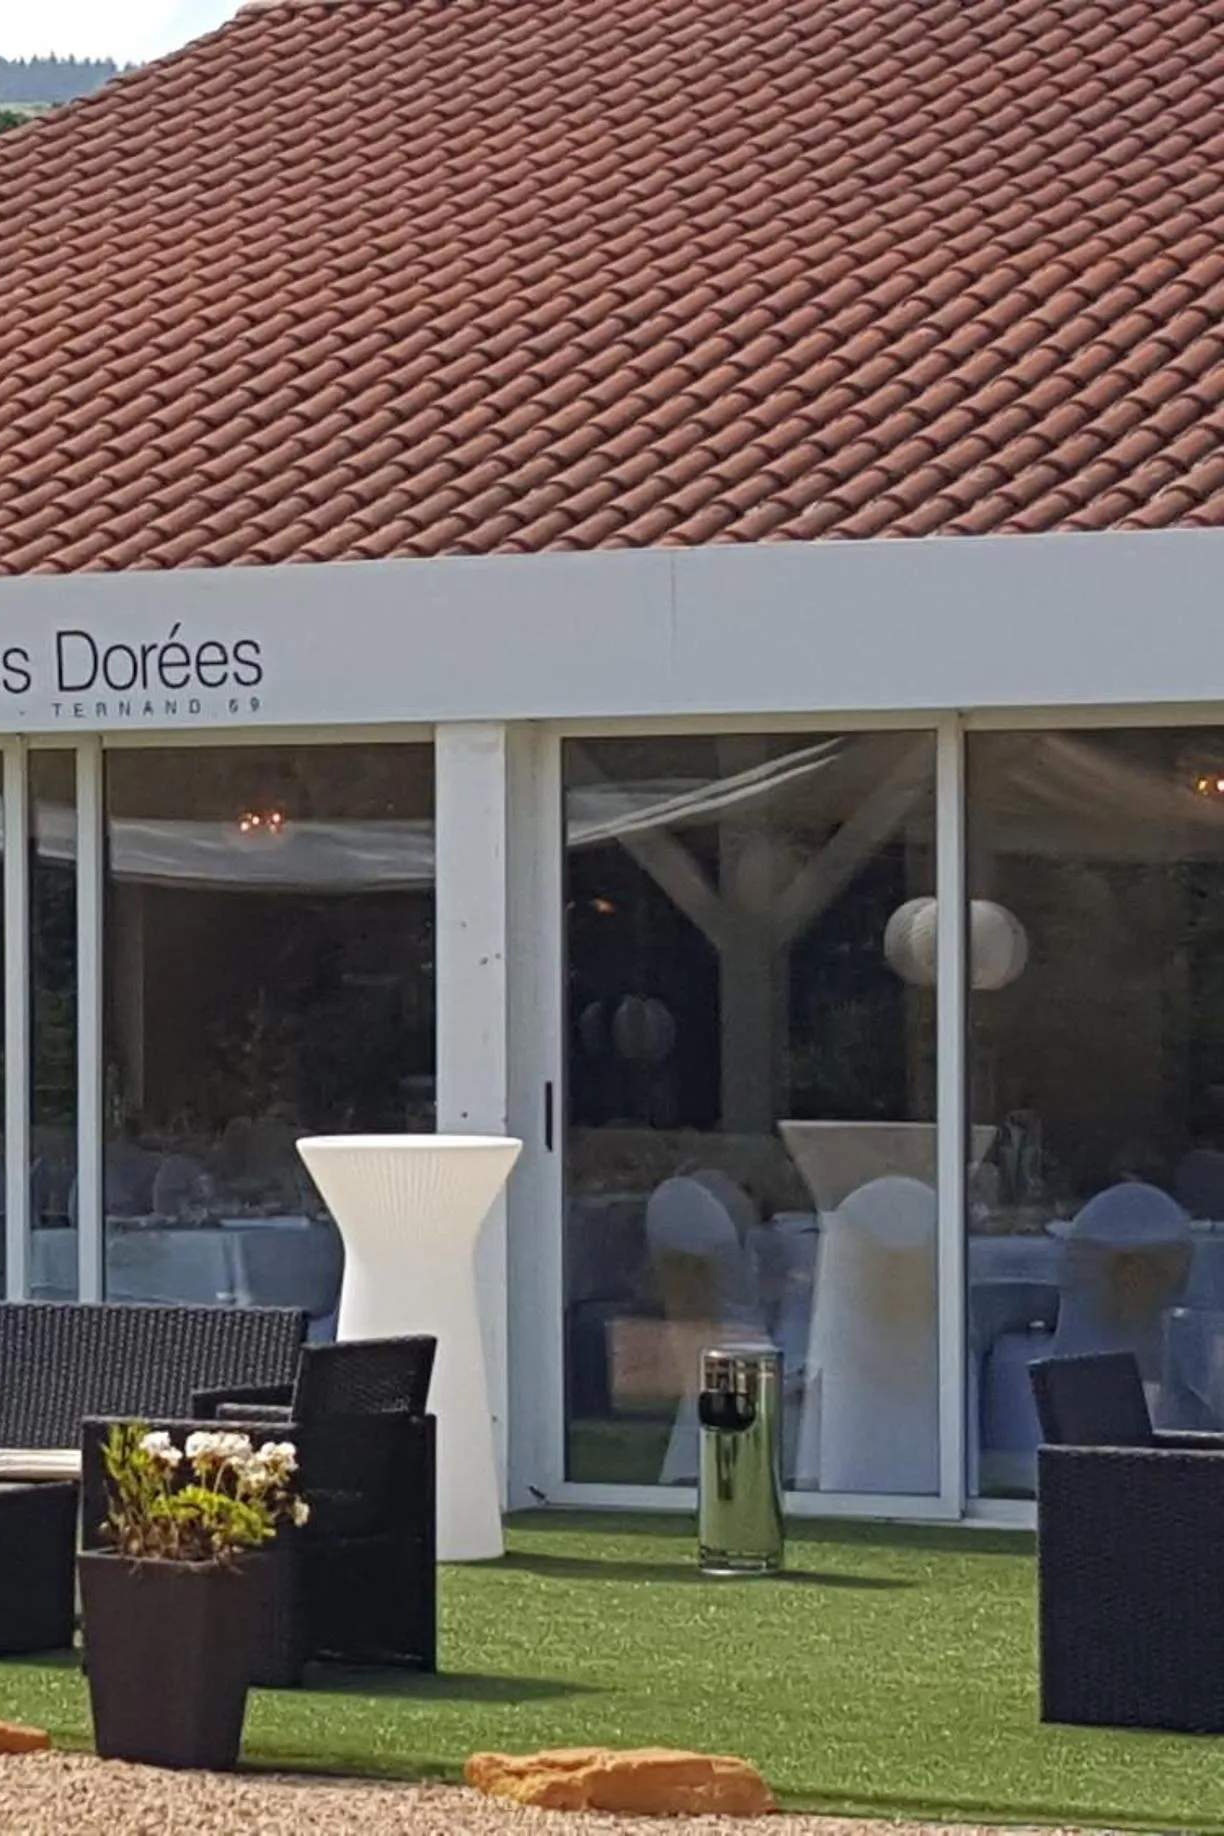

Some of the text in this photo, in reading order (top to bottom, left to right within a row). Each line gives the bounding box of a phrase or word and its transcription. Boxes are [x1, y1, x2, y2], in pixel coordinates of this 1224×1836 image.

[56, 623, 263, 693] Dorées
[52, 699, 202, 718] TERNAND
[228, 697, 260, 714] 69
